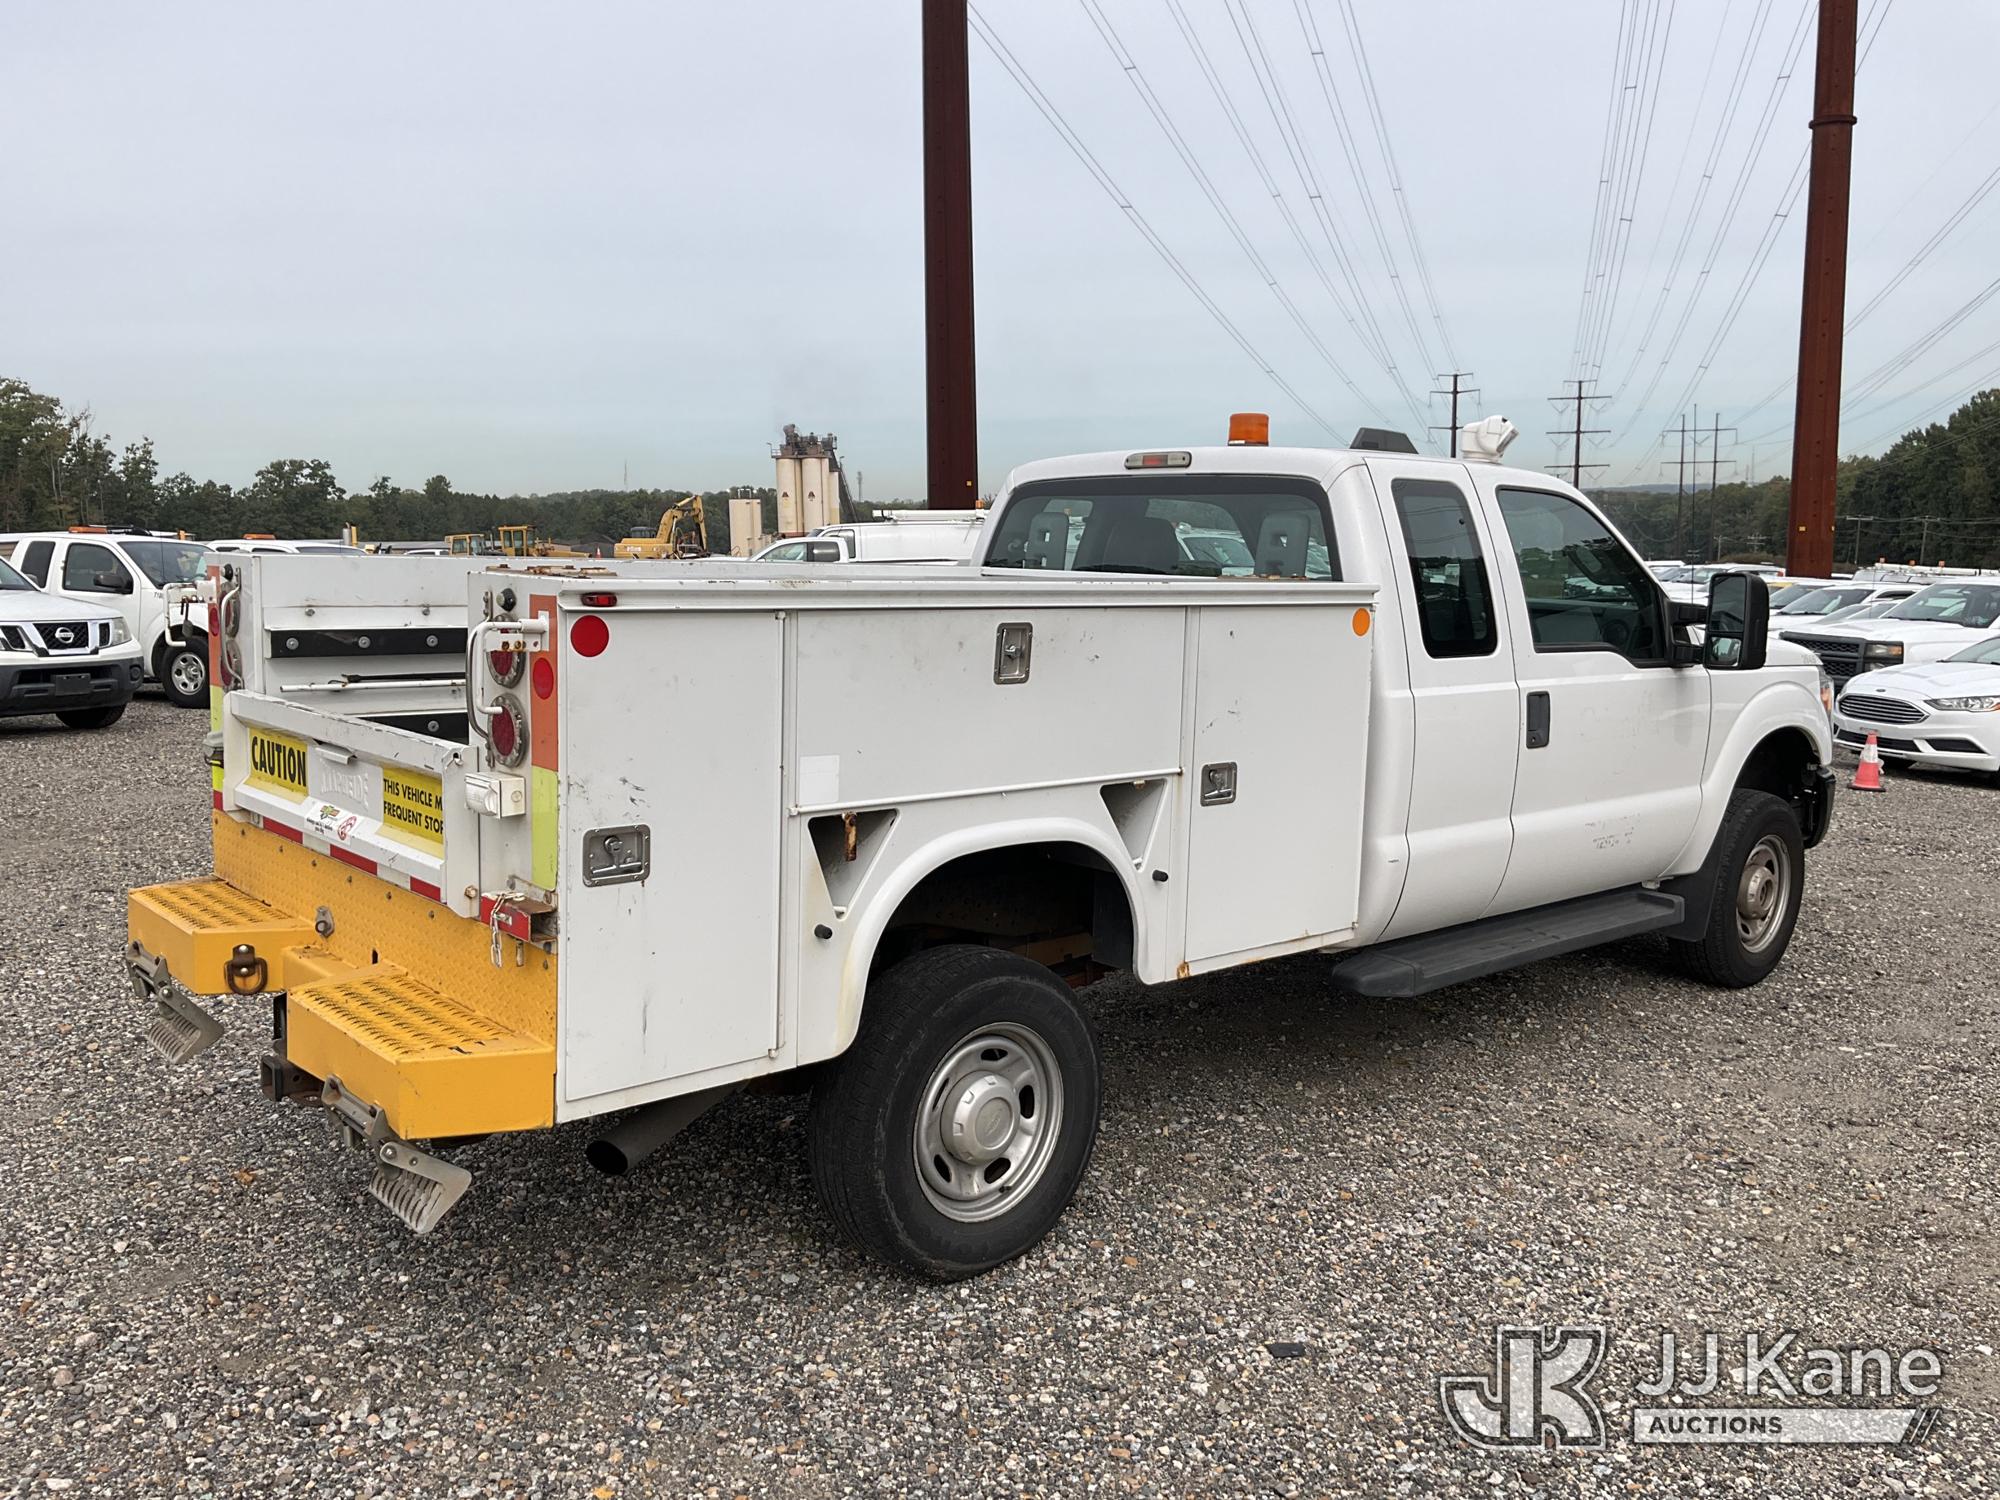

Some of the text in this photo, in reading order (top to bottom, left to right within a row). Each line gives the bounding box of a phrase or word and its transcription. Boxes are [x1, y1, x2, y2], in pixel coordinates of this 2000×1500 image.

[251, 736, 307, 787] CAUTION
[383, 778, 400, 796] THIS
[401, 784, 433, 808] VEHICLE
[383, 801, 423, 827] FREQUENT
